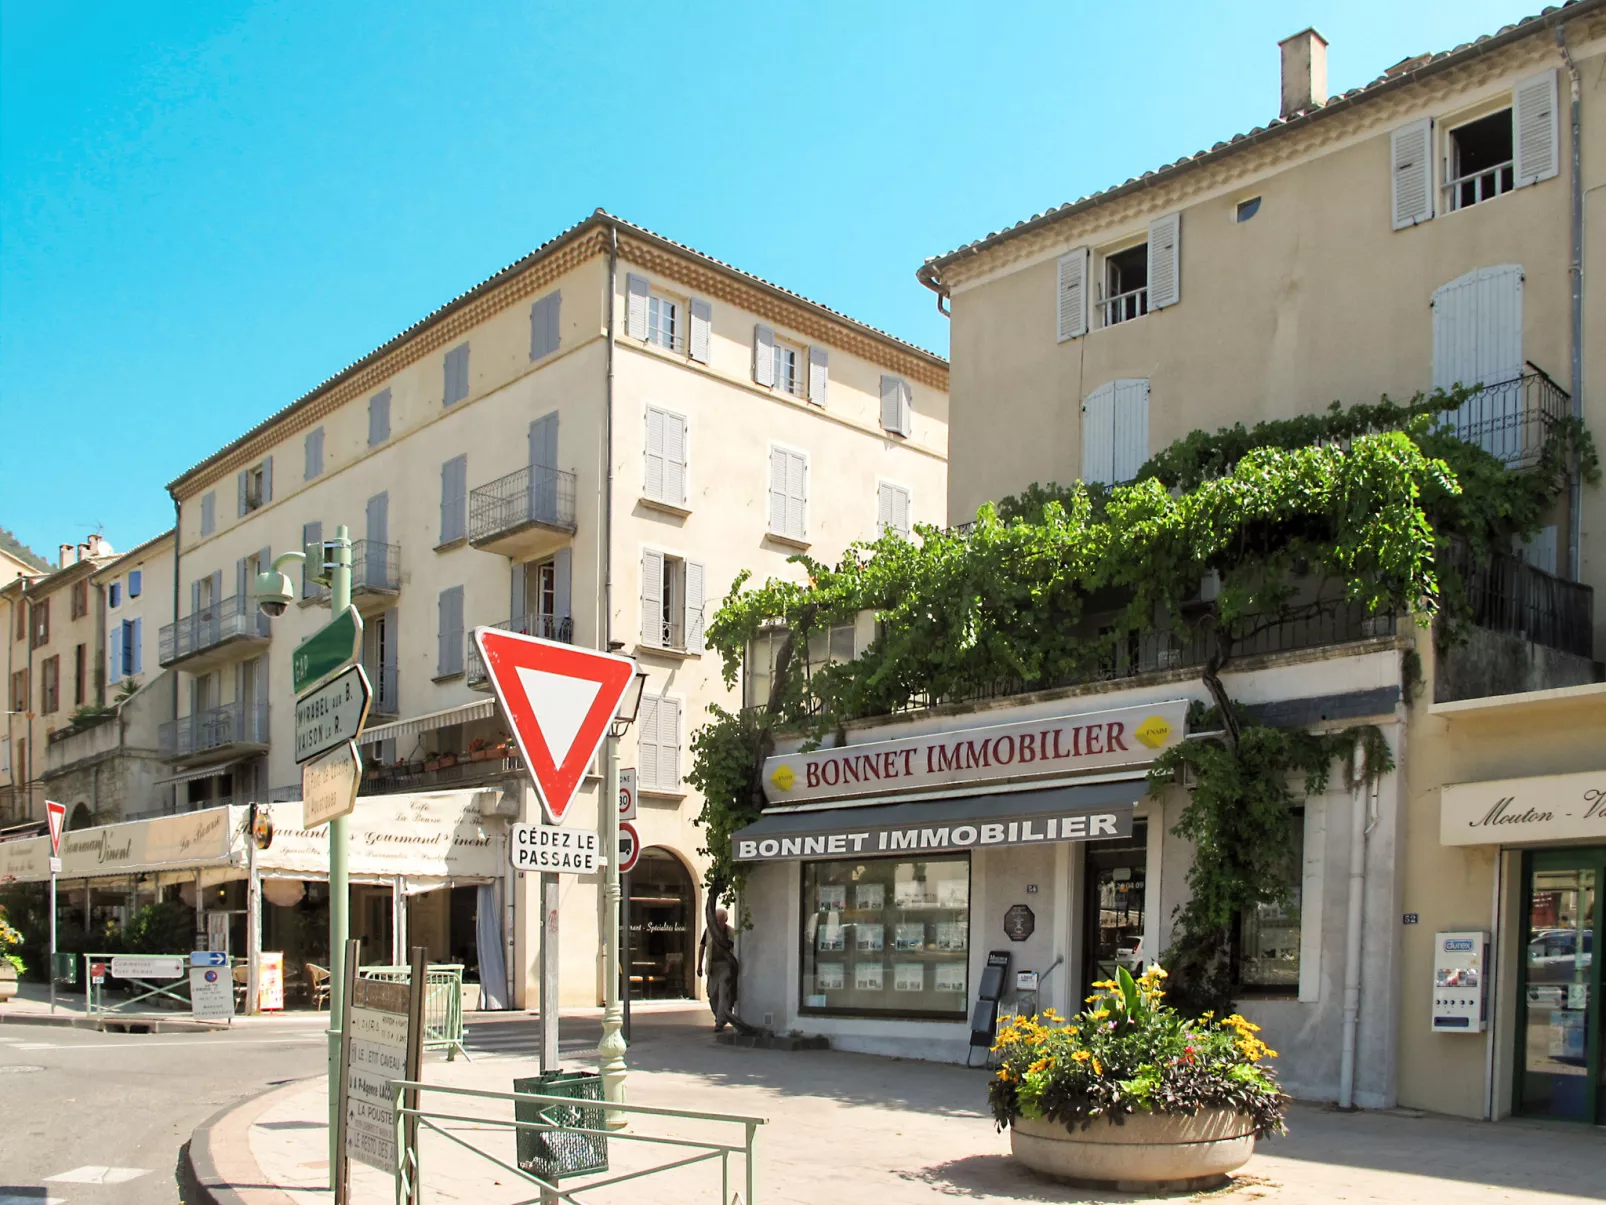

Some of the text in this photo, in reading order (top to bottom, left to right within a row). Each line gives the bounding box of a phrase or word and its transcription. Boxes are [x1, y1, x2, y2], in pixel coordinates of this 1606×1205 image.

[295, 654, 309, 683] GAP
[298, 696, 329, 729] MIRABEL
[346, 682, 353, 702] B.
[298, 724, 324, 752] VAISON
[334, 715, 342, 735] R.
[1146, 727, 1167, 736] FNAIM
[806, 721, 1129, 788] BONNET IMMOBILIER
[619, 775, 630, 783] ONE
[619, 795, 628, 806] 30
[1469, 796, 1554, 827] Mouton
[364, 831, 441, 845] Gourmand
[519, 828, 594, 849] CÉDEZ LE
[738, 814, 1118, 858] BONNET IMMOBILIER
[519, 850, 593, 869] PASSAGE
[1404, 915, 1416, 923] 52
[1446, 941, 1472, 950] durex
[358, 1048, 364, 1060] LE
[365, 1049, 378, 1063] ETIT
[381, 1053, 400, 1070] CAVEAU
[357, 1103, 394, 1125] LA POUSTE
[354, 1132, 360, 1148] LE
[361, 1134, 376, 1155] RESTO
[378, 1141, 388, 1159] DES
